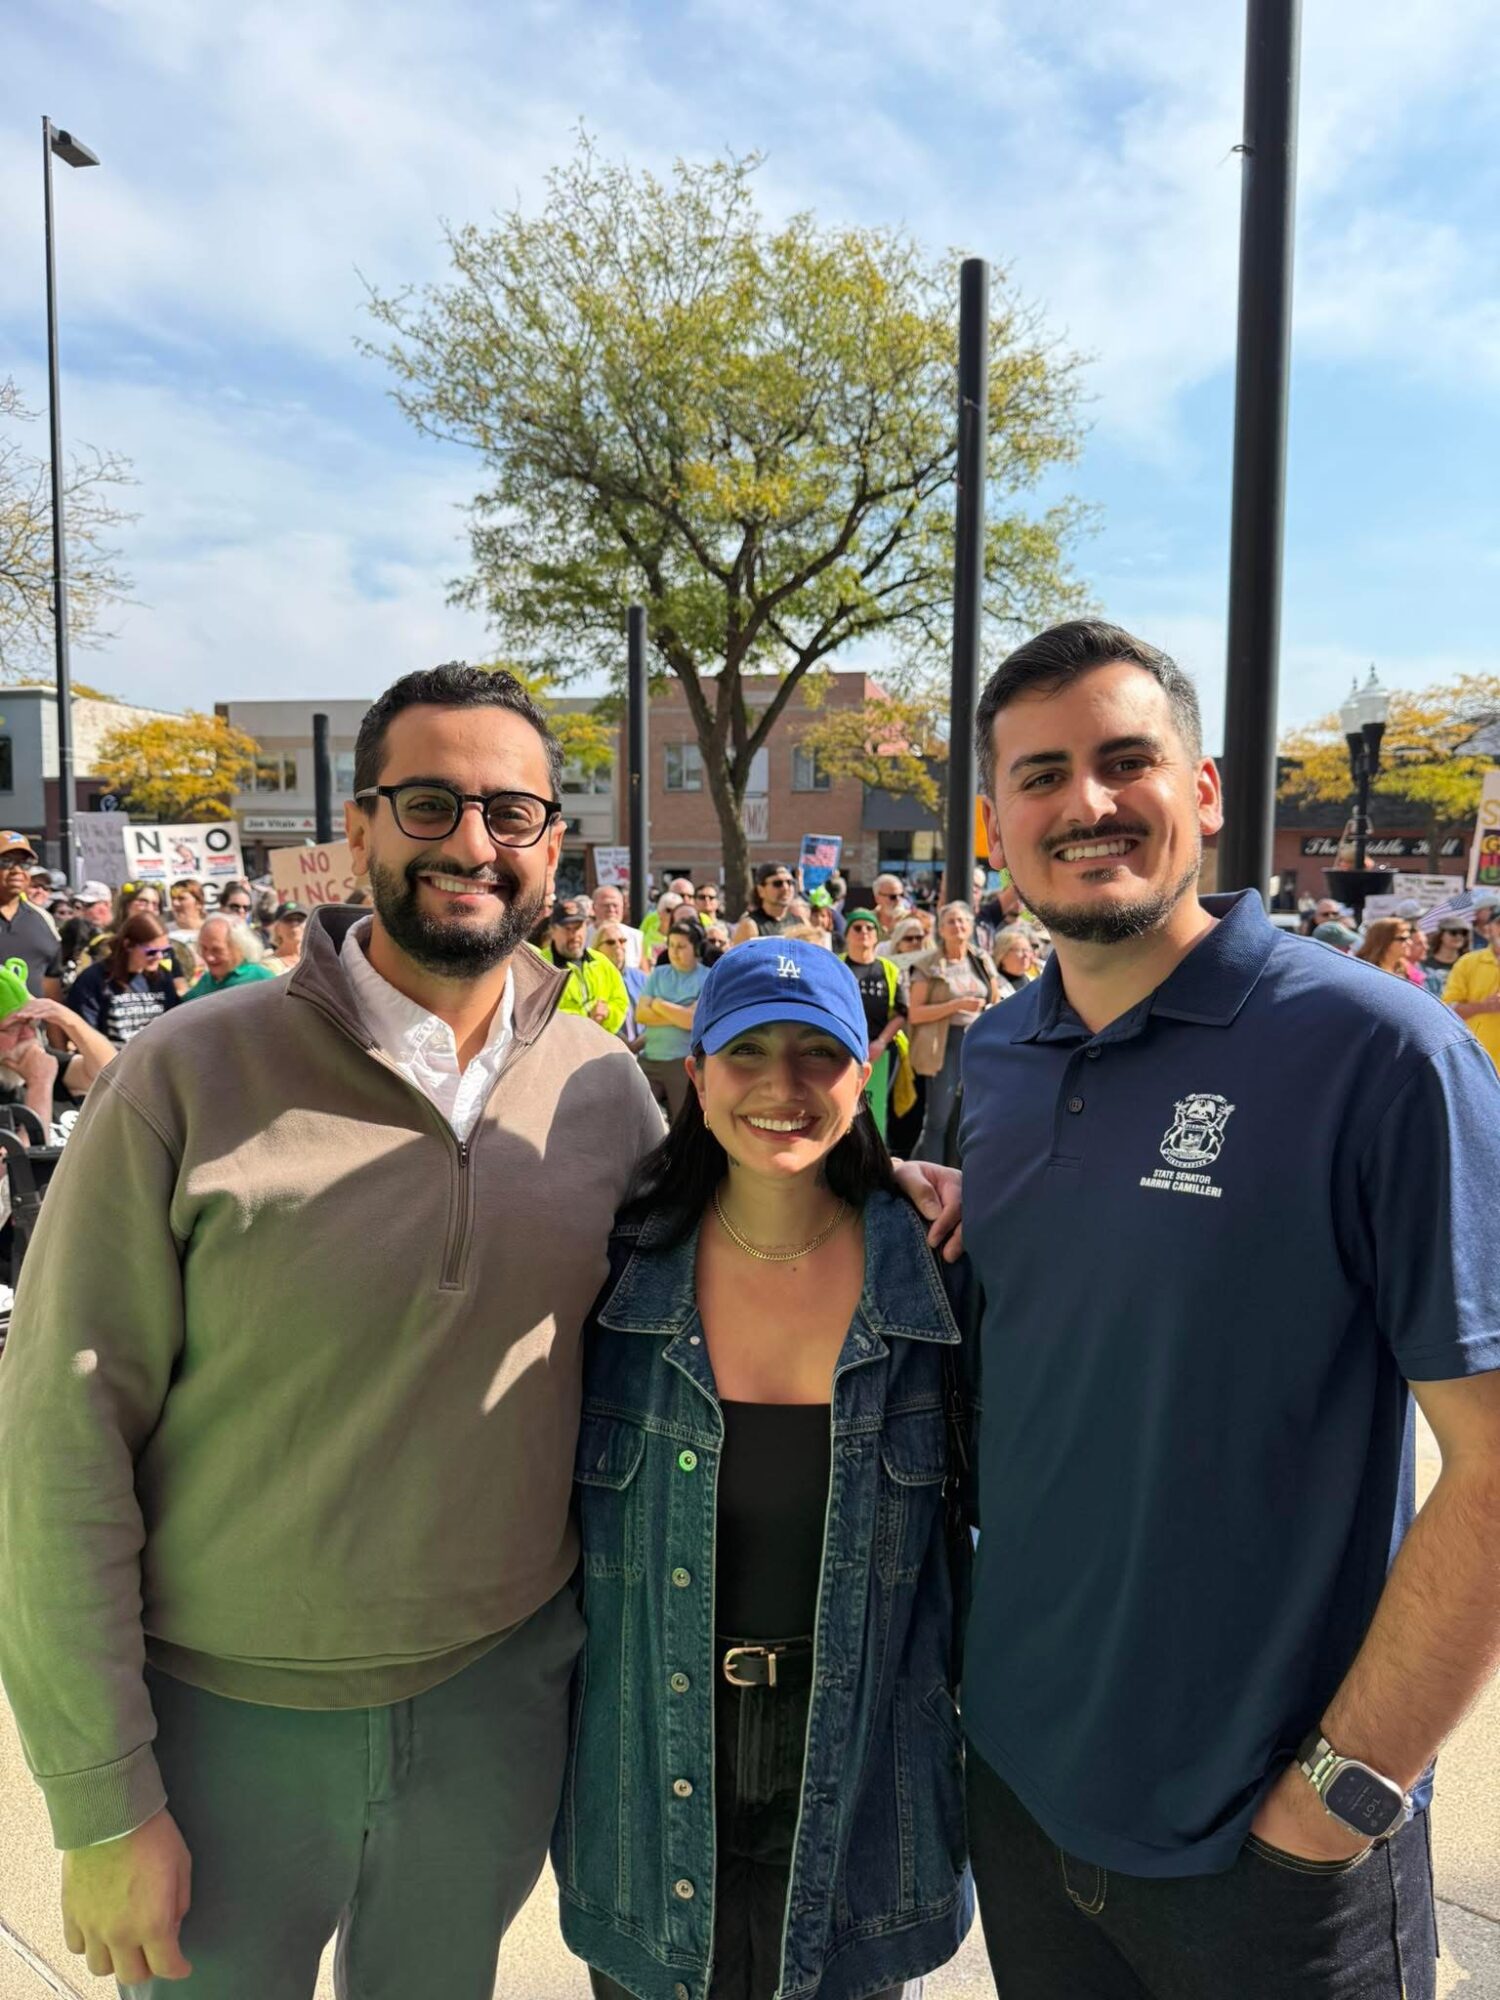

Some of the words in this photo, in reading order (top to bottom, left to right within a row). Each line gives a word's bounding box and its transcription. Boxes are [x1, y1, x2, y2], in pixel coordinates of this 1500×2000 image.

[248, 819, 264, 828] Joe
[267, 818, 296, 828] Vitale
[1304, 838, 1337, 854] The
[299, 851, 330, 875] NO
[776, 955, 801, 979] LA
[1153, 1169, 1175, 1178] STATE
[1175, 1171, 1211, 1184] SENATOR
[1140, 1177, 1171, 1190] DARRIN
[1172, 1181, 1223, 1198] CAMILLERI
